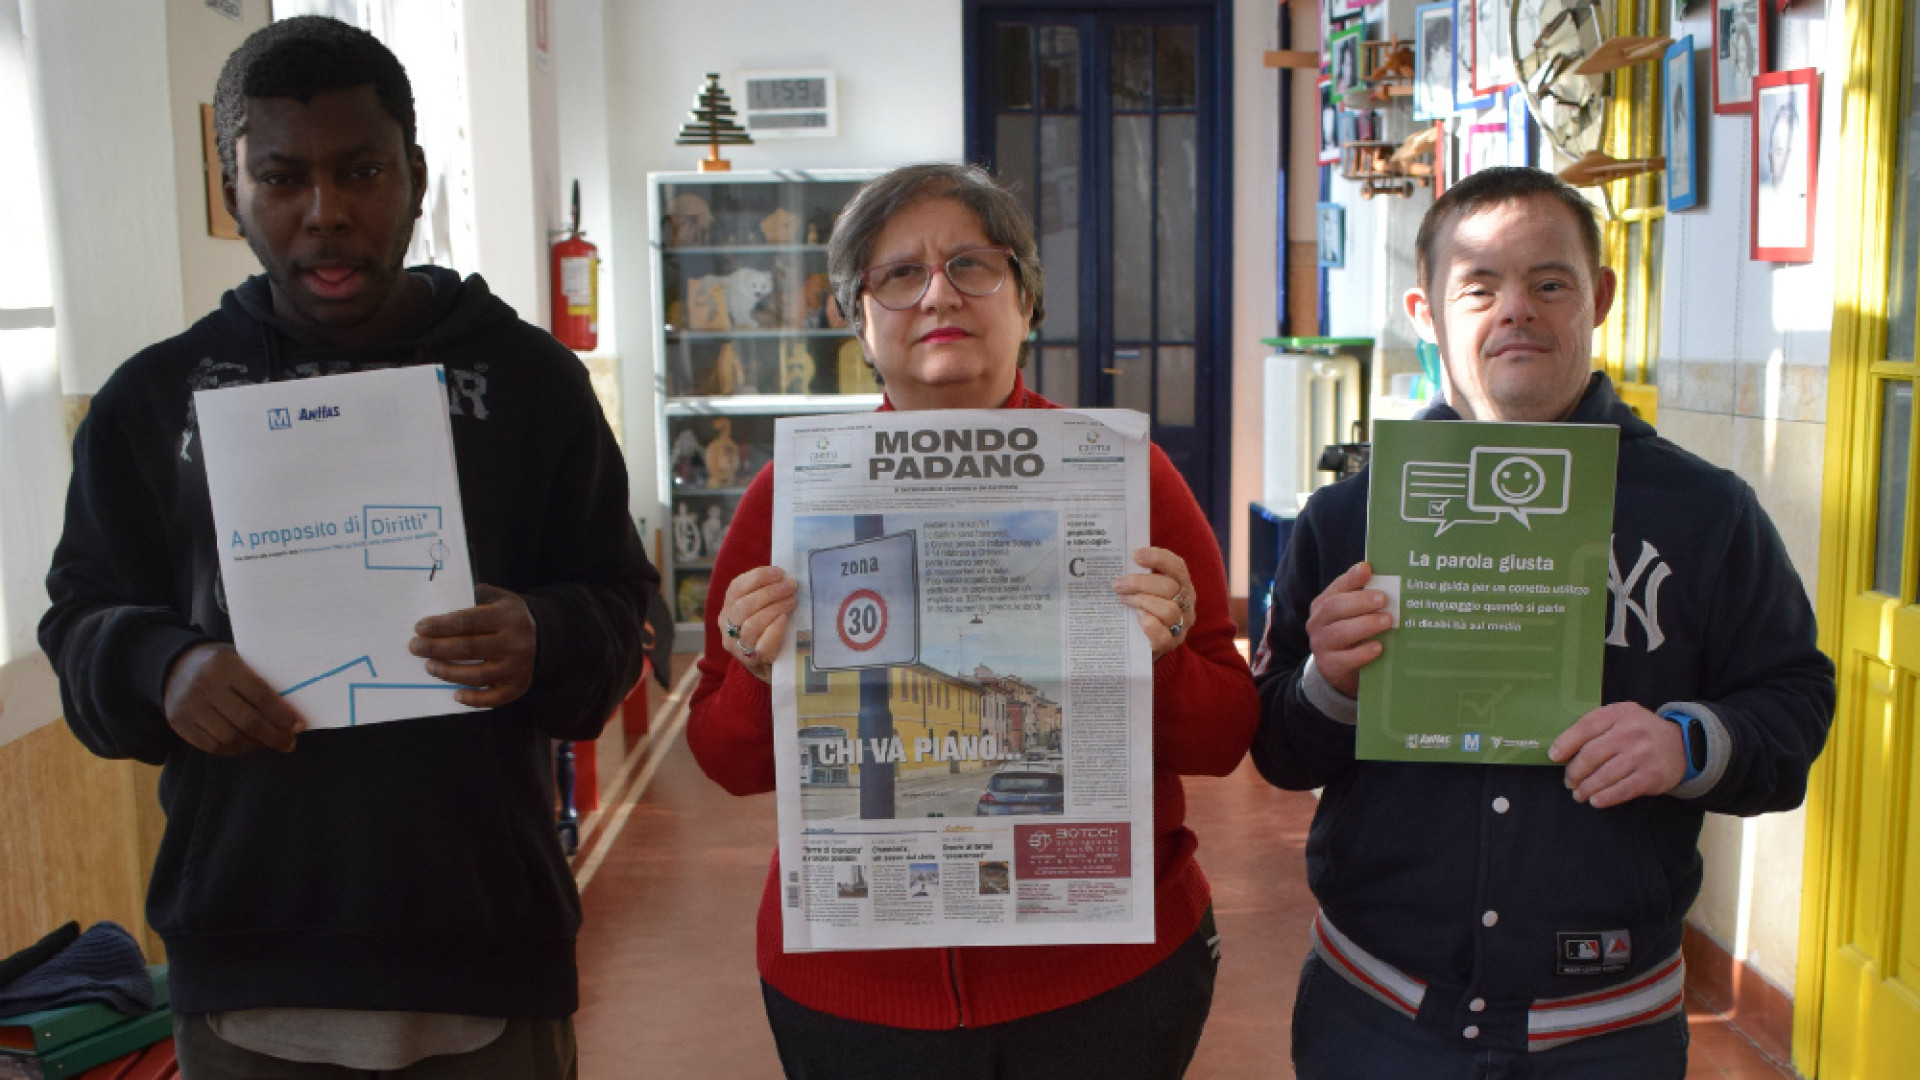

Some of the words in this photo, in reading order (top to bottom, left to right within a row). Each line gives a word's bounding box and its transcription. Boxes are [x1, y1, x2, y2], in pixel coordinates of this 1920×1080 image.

[875, 427, 1038, 454] MONDO
[869, 453, 1045, 480] PADANO
[232, 529, 244, 548] A
[249, 521, 337, 549] proposito
[344, 515, 360, 534] di
[841, 556, 879, 576] zona
[1409, 550, 1429, 567] La
[1435, 554, 1493, 571] parola
[1499, 554, 1554, 572] giusta
[1439, 581, 1470, 593] guida
[1472, 583, 1490, 594] per
[1552, 585, 1590, 596] utilizzo
[1405, 599, 1423, 609] del
[1426, 600, 1480, 613] linguaggio
[1483, 602, 1523, 613] quando
[1526, 602, 1535, 613] si
[848, 604, 877, 635] 30
[1405, 618, 1416, 628] di
[818, 738, 863, 765] CHI
[870, 736, 907, 764] VA
[913, 733, 1021, 763] PIANO...
[1464, 734, 1479, 750] M
